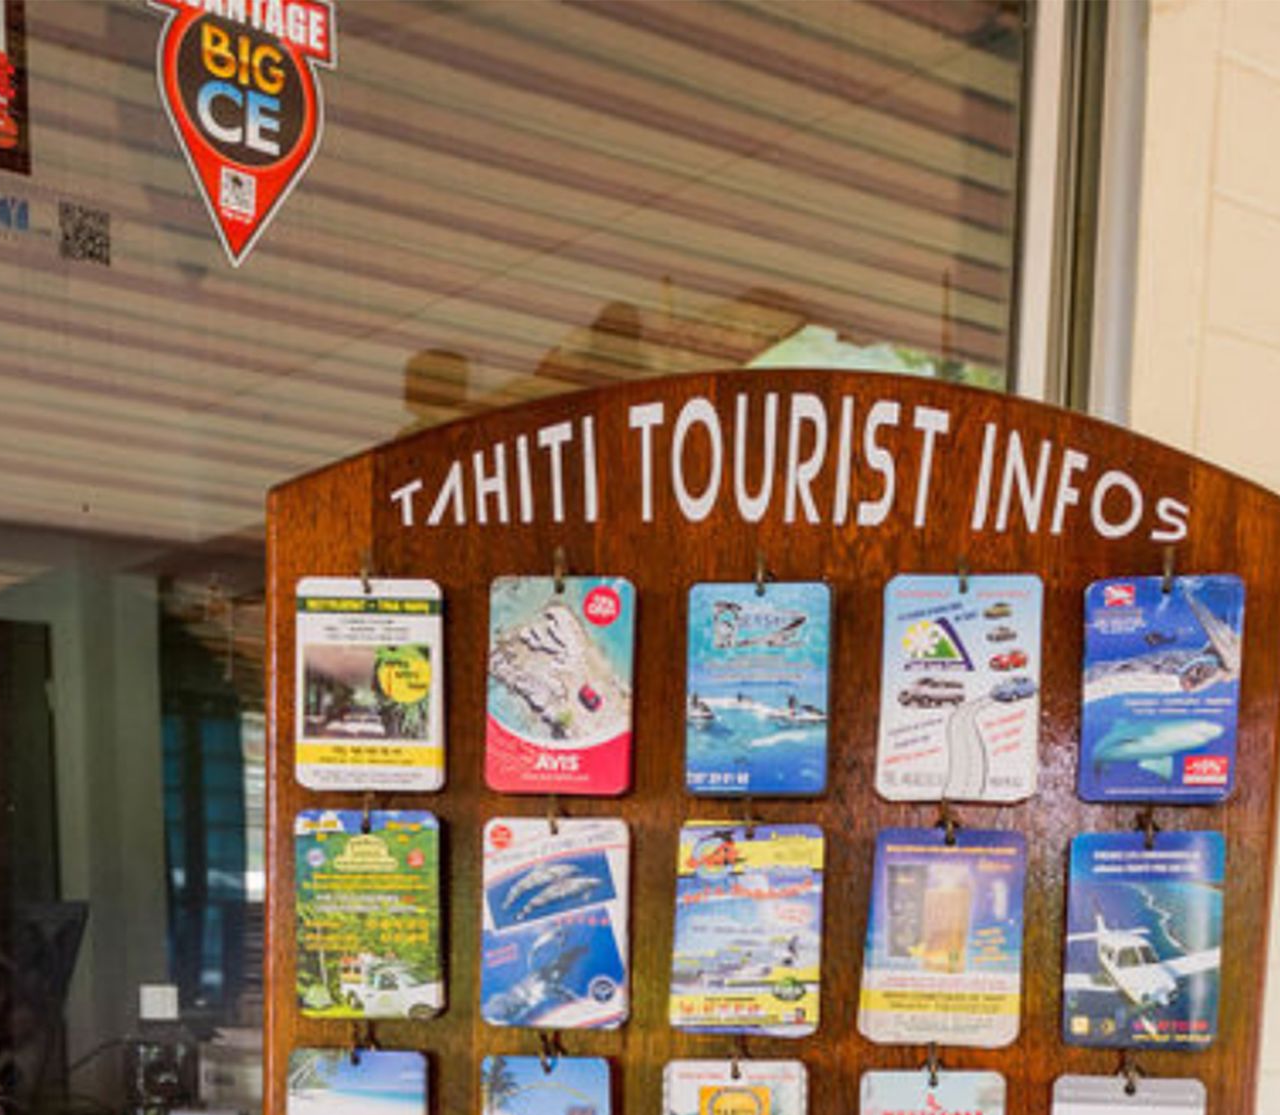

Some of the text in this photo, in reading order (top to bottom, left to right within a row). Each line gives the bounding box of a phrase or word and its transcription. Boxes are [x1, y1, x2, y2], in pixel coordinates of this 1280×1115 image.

[183, 0, 326, 51] NTAGE
[201, 22, 286, 95] BIG
[197, 80, 281, 156] CE
[390, 392, 1192, 542] TAHITI TOURIST INFOS
[535, 755, 580, 771] AVIS
